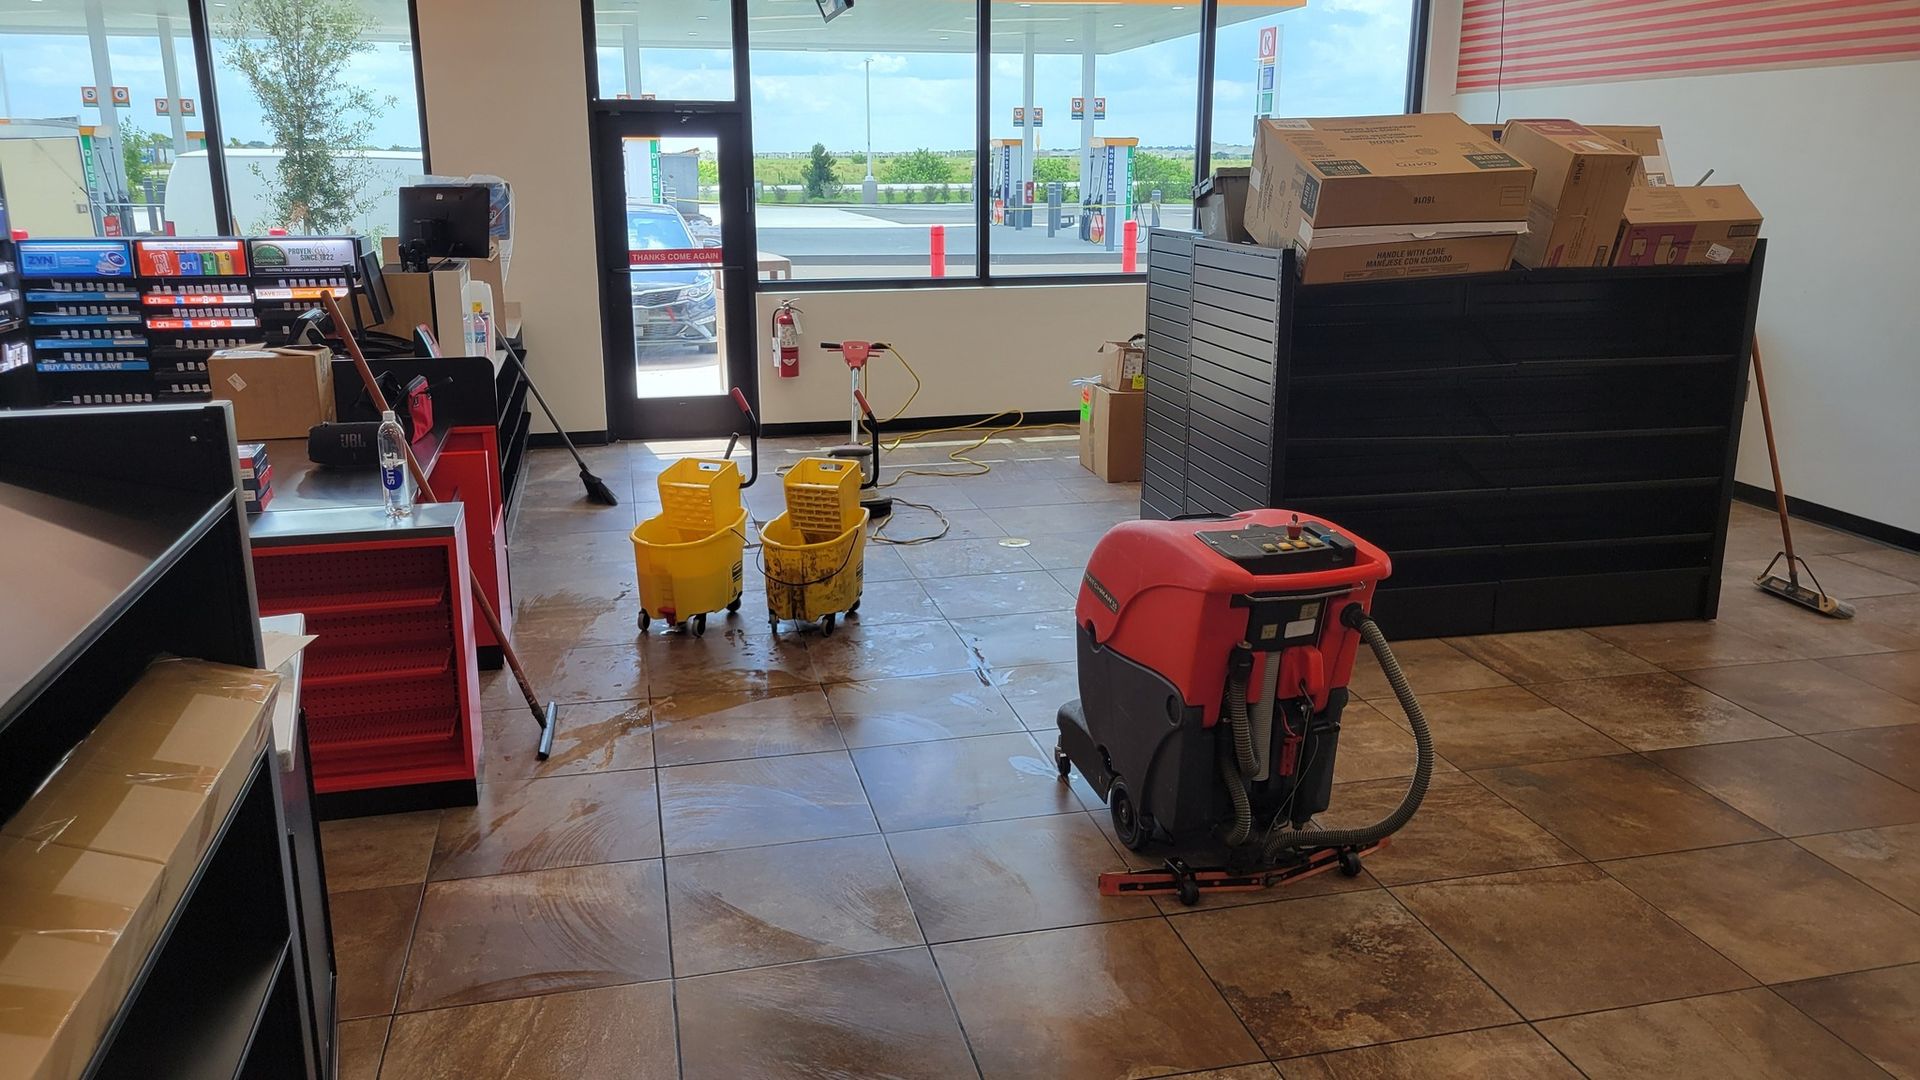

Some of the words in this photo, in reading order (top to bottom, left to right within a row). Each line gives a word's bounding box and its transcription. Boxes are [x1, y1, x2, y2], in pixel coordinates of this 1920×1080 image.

[86, 90, 94, 98] 5
[117, 90, 124, 98] 6
[632, 253, 666, 261] THANKS
[693, 252, 719, 260] AGAIN
[1377, 250, 1404, 259] HANDLE
[1407, 249, 1426, 257] WITH
[1427, 248, 1445, 256] CARE
[28, 256, 53, 265] ZYN
[1404, 257, 1419, 266] CON
[1421, 255, 1452, 264] CUIDADO
[341, 433, 366, 448] JBL
